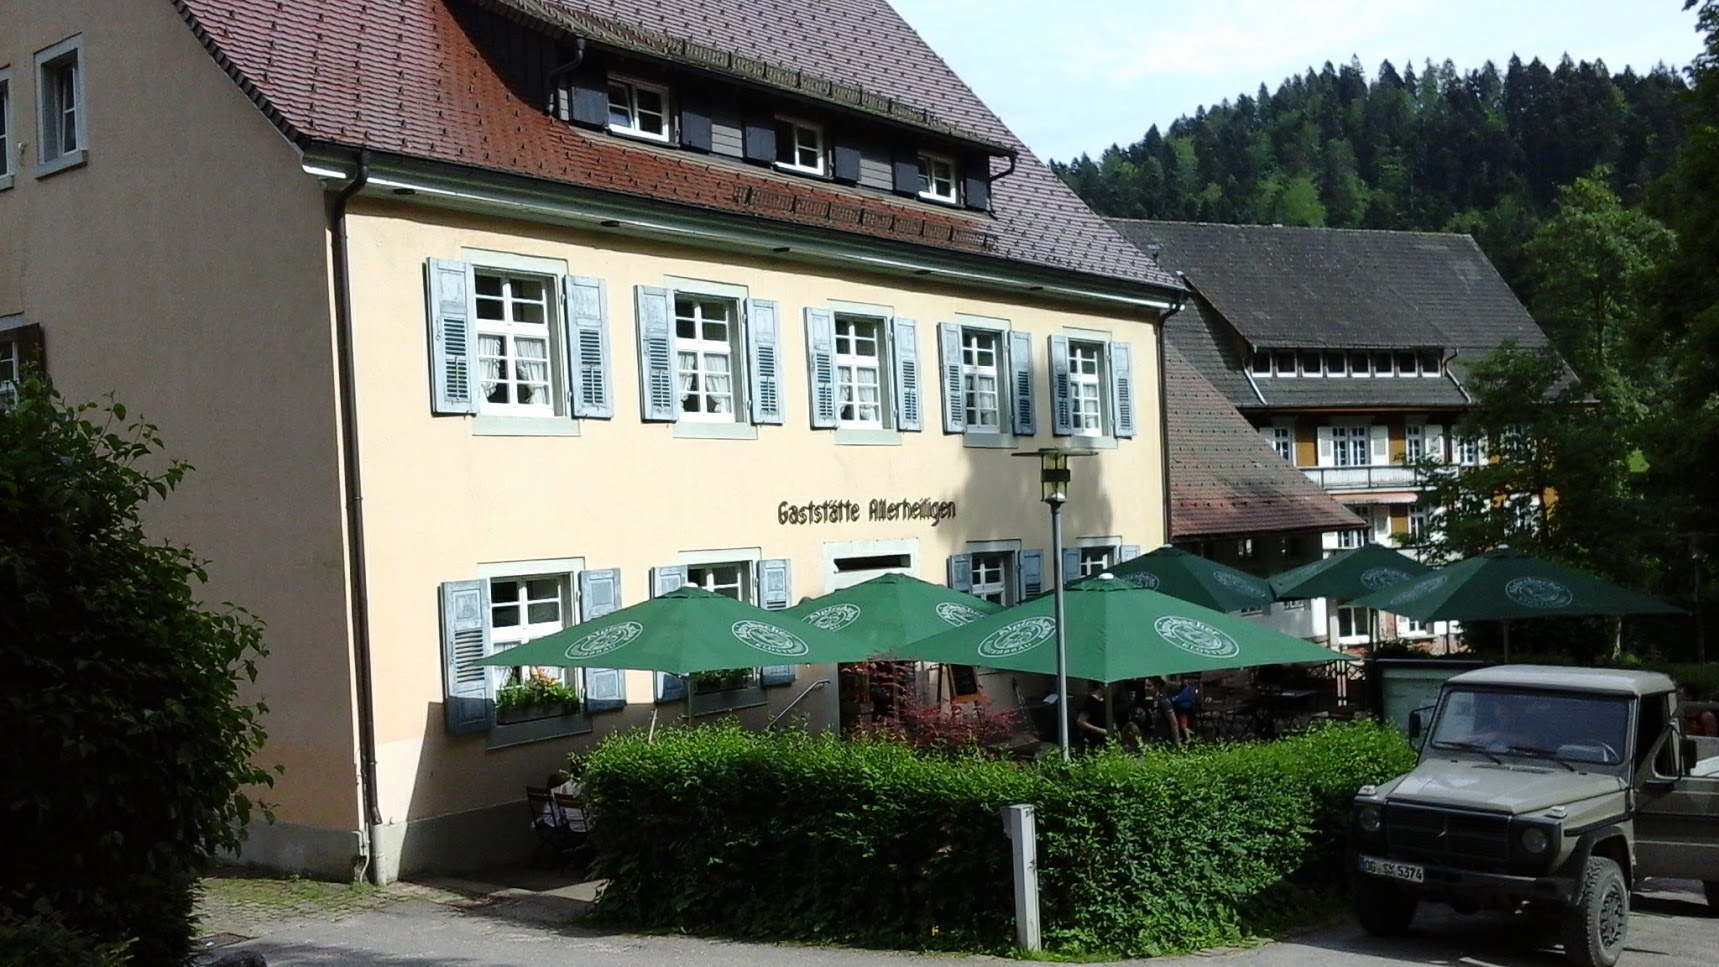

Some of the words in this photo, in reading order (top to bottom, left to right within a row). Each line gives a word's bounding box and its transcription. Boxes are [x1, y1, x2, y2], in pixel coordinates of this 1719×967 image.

[778, 500, 860, 525] Gaststätte
[869, 497, 956, 526] Allerheiligen
[1397, 865, 1422, 881] 5374
